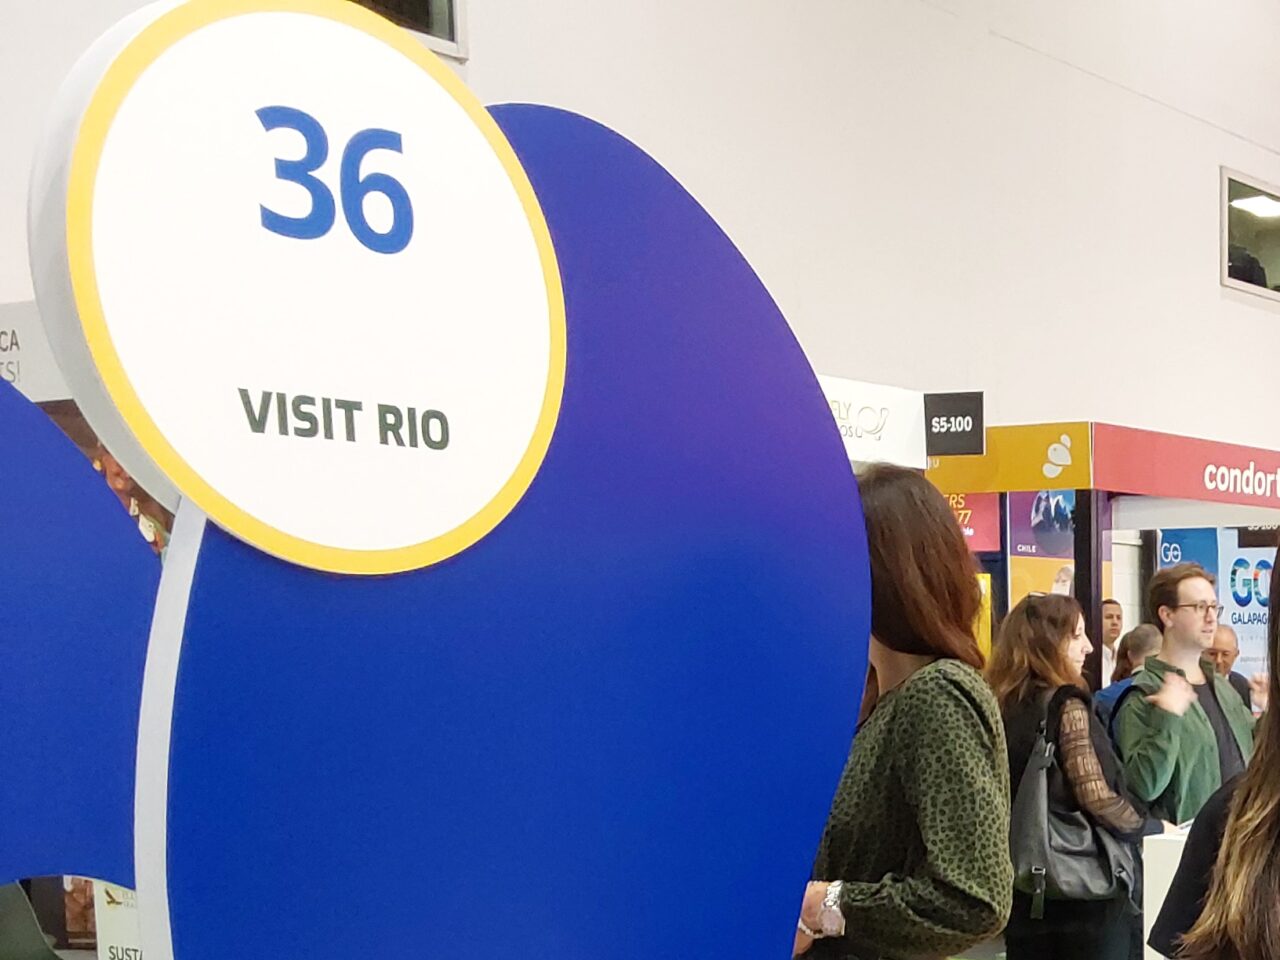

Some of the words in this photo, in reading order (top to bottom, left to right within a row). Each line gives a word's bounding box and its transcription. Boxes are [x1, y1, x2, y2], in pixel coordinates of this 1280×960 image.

[254, 105, 414, 254] 36
[238, 387, 362, 442] VISIT
[377, 404, 450, 450] RIO
[931, 415, 973, 433] S5-100
[1017, 544, 1037, 553] CHILE
[1161, 543, 1181, 562] GO
[1231, 612, 1270, 625] GALAPAG
